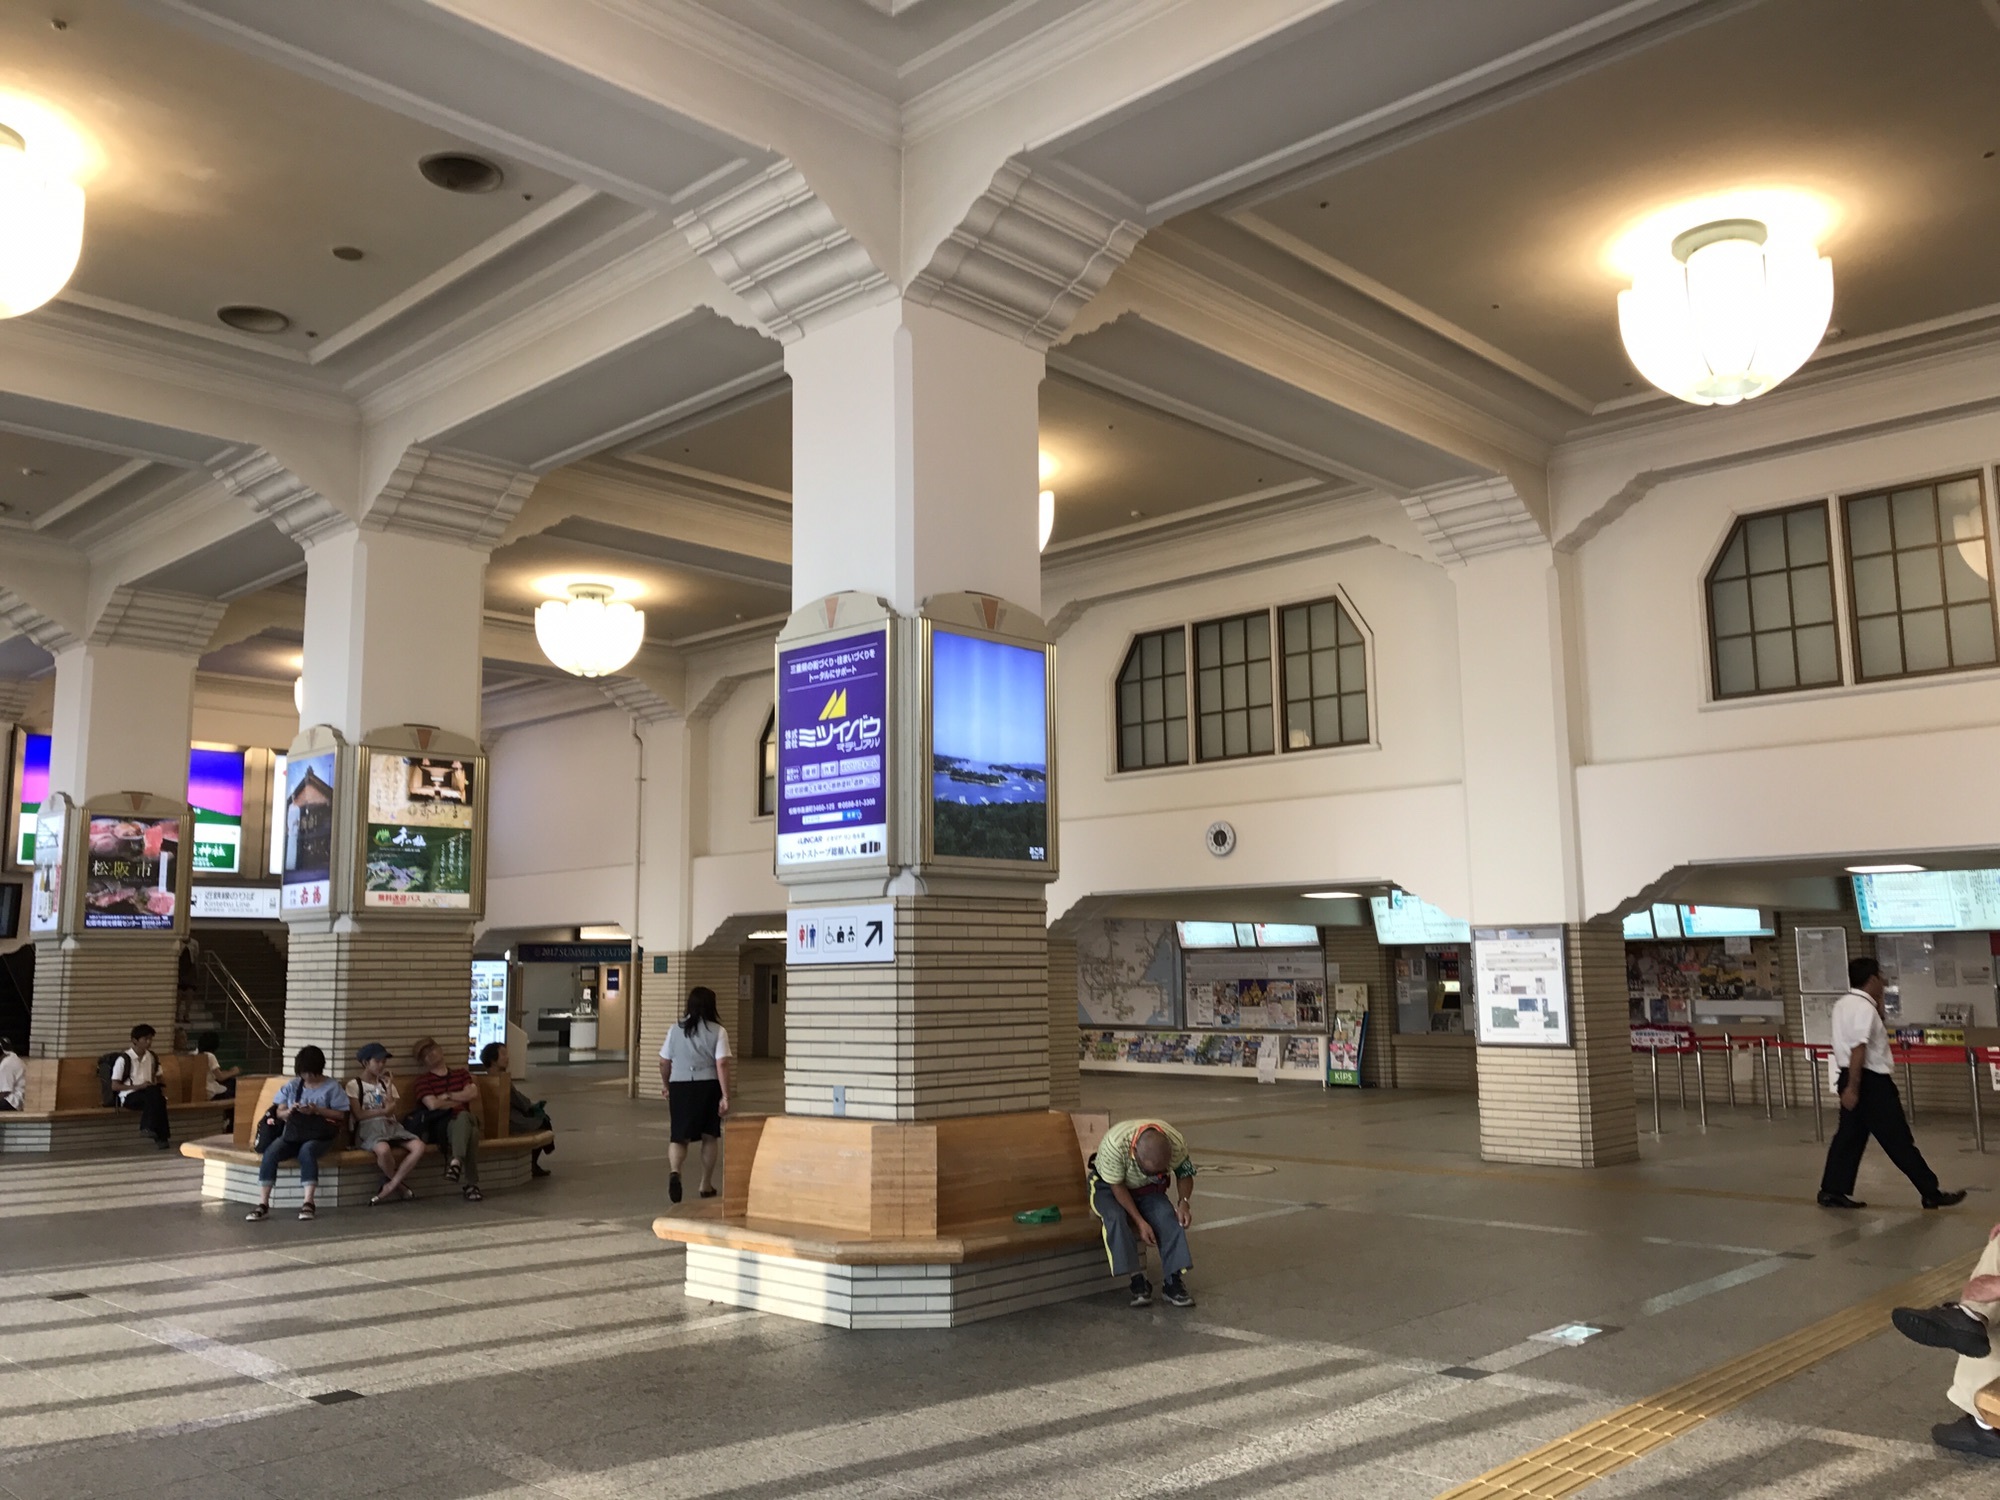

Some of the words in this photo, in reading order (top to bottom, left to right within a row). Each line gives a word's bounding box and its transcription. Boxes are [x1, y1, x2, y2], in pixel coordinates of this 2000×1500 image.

[798, 714, 881, 748] ミツイバウ
